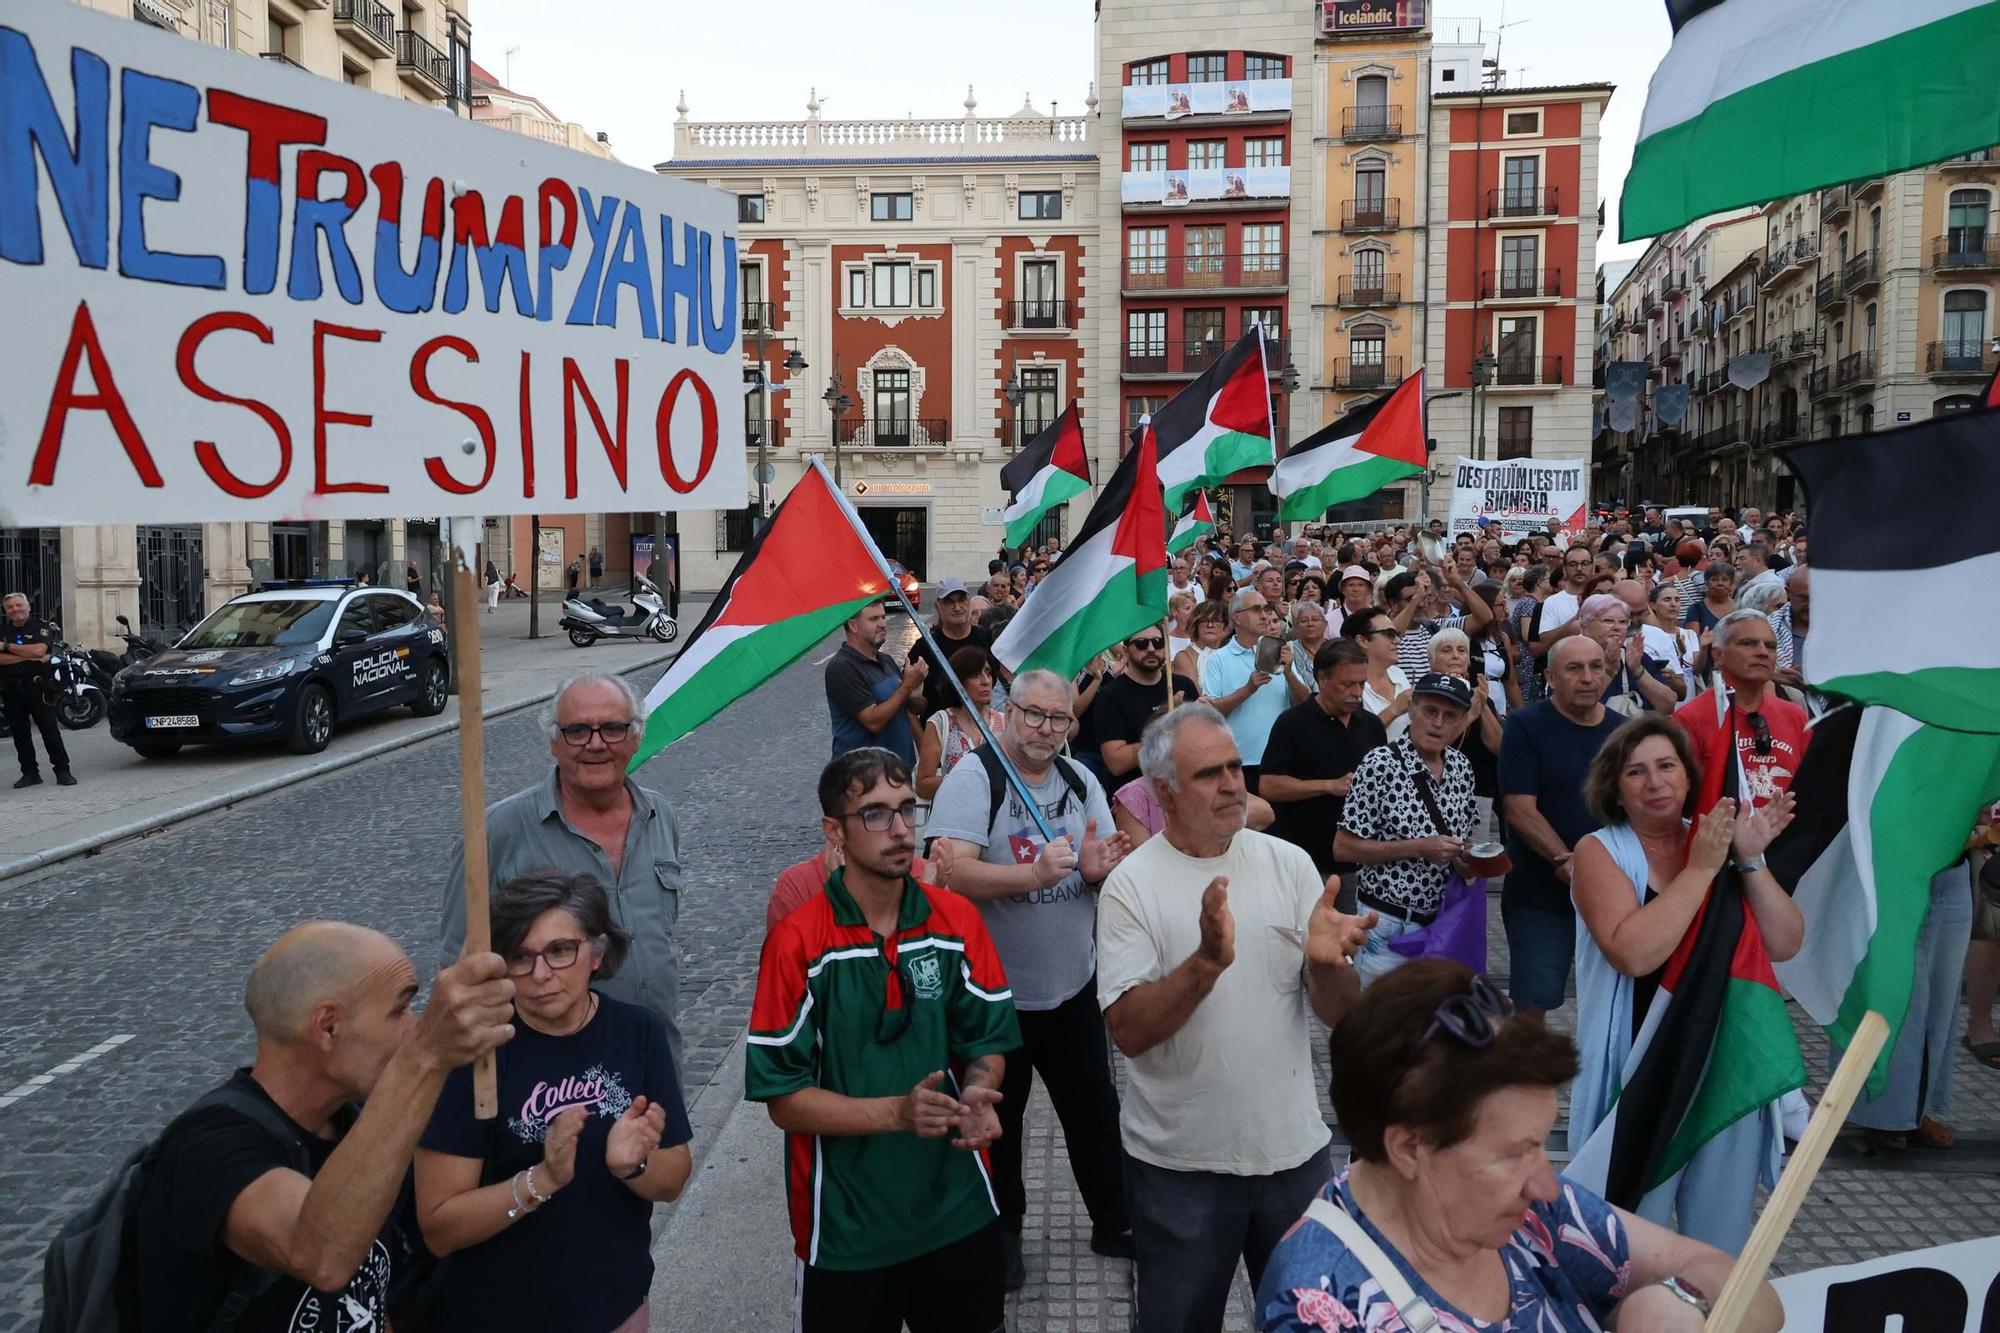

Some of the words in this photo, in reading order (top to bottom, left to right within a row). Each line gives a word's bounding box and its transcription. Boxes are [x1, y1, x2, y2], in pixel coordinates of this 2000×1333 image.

[1339, 8, 1393, 25] Icelandic
[0, 25, 737, 354] NETRUMPYAHU
[28, 300, 719, 499] ASESINO
[1457, 464, 1527, 490] DESTRUÏM
[1529, 468, 1580, 492] L'ESTAT
[1485, 490, 1548, 512] SIONISTA
[353, 660, 410, 687] NACIONAL
[521, 1075, 607, 1124] Collect
